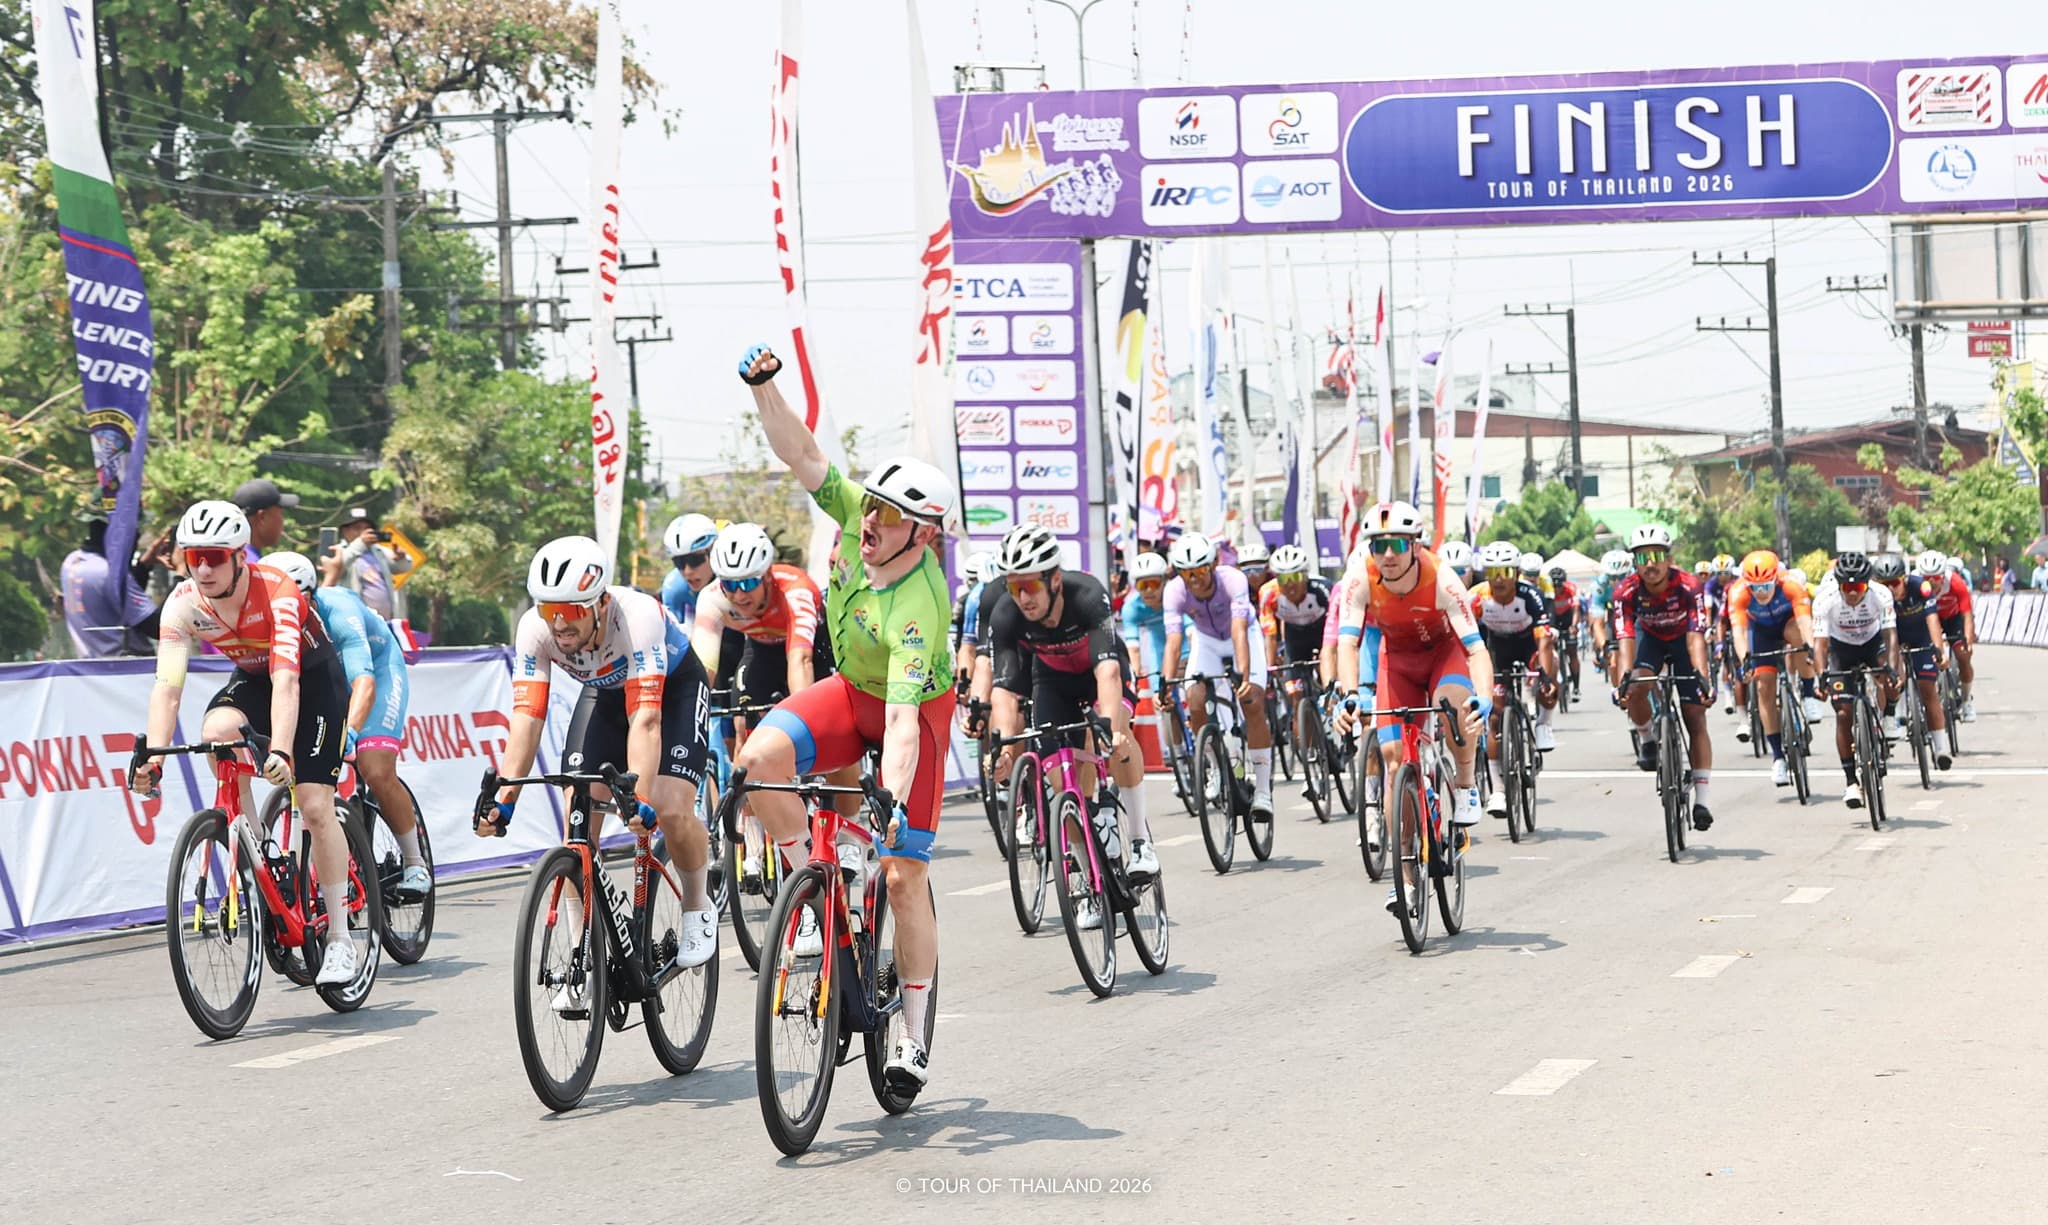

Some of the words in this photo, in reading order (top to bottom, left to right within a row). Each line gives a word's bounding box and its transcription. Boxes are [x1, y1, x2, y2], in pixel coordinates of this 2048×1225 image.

[1170, 134, 1208, 146] NSDF
[1273, 133, 1310, 146] SAT
[1457, 94, 1796, 177] FINISH
[1289, 182, 1332, 197] AOT
[1488, 181, 1534, 198] TOUR
[1548, 180, 1568, 197] OF
[1581, 176, 1672, 196] THAILAND
[1687, 175, 1733, 192] 2026
[967, 278, 1026, 298] TCA
[270, 597, 300, 665] ANTA
[524, 653, 536, 677] EPIC
[652, 645, 664, 671] EPIC
